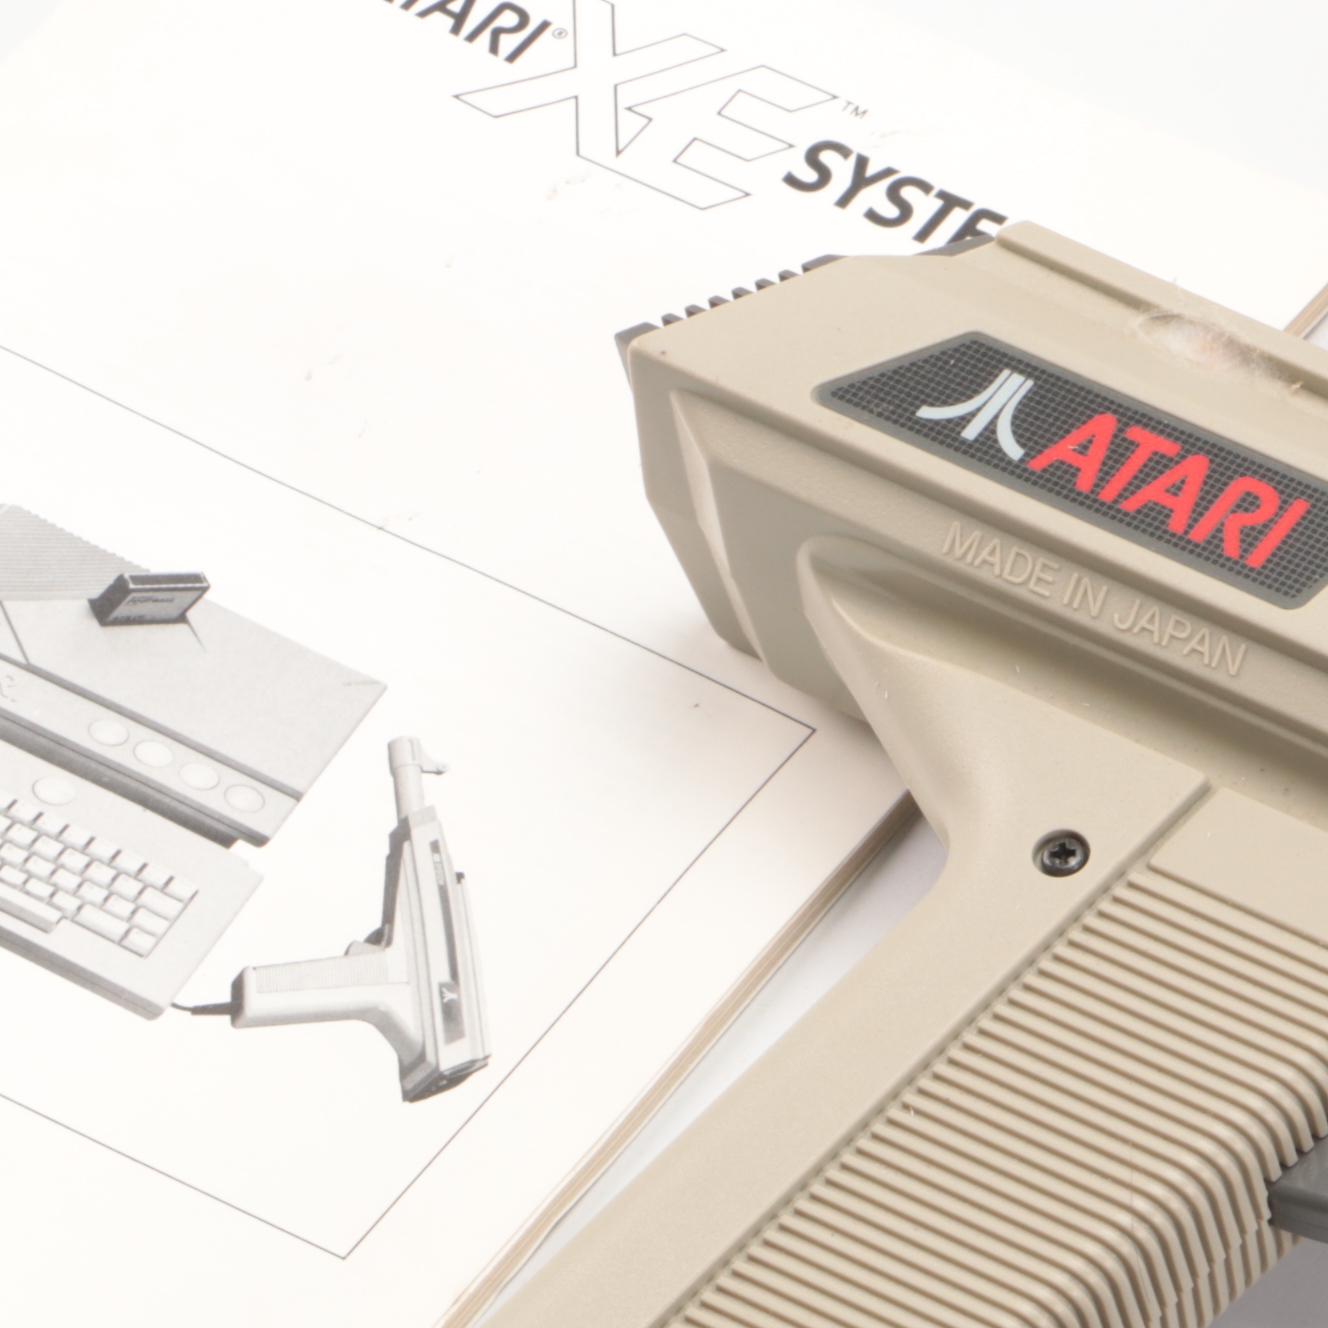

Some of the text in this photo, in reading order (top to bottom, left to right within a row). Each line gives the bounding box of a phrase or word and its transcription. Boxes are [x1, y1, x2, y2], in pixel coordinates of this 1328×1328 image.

[782, 140, 1008, 245] SYSTE
[1026, 412, 1310, 569] ATARI
[942, 521, 1248, 678] MADE IN JAPAN
